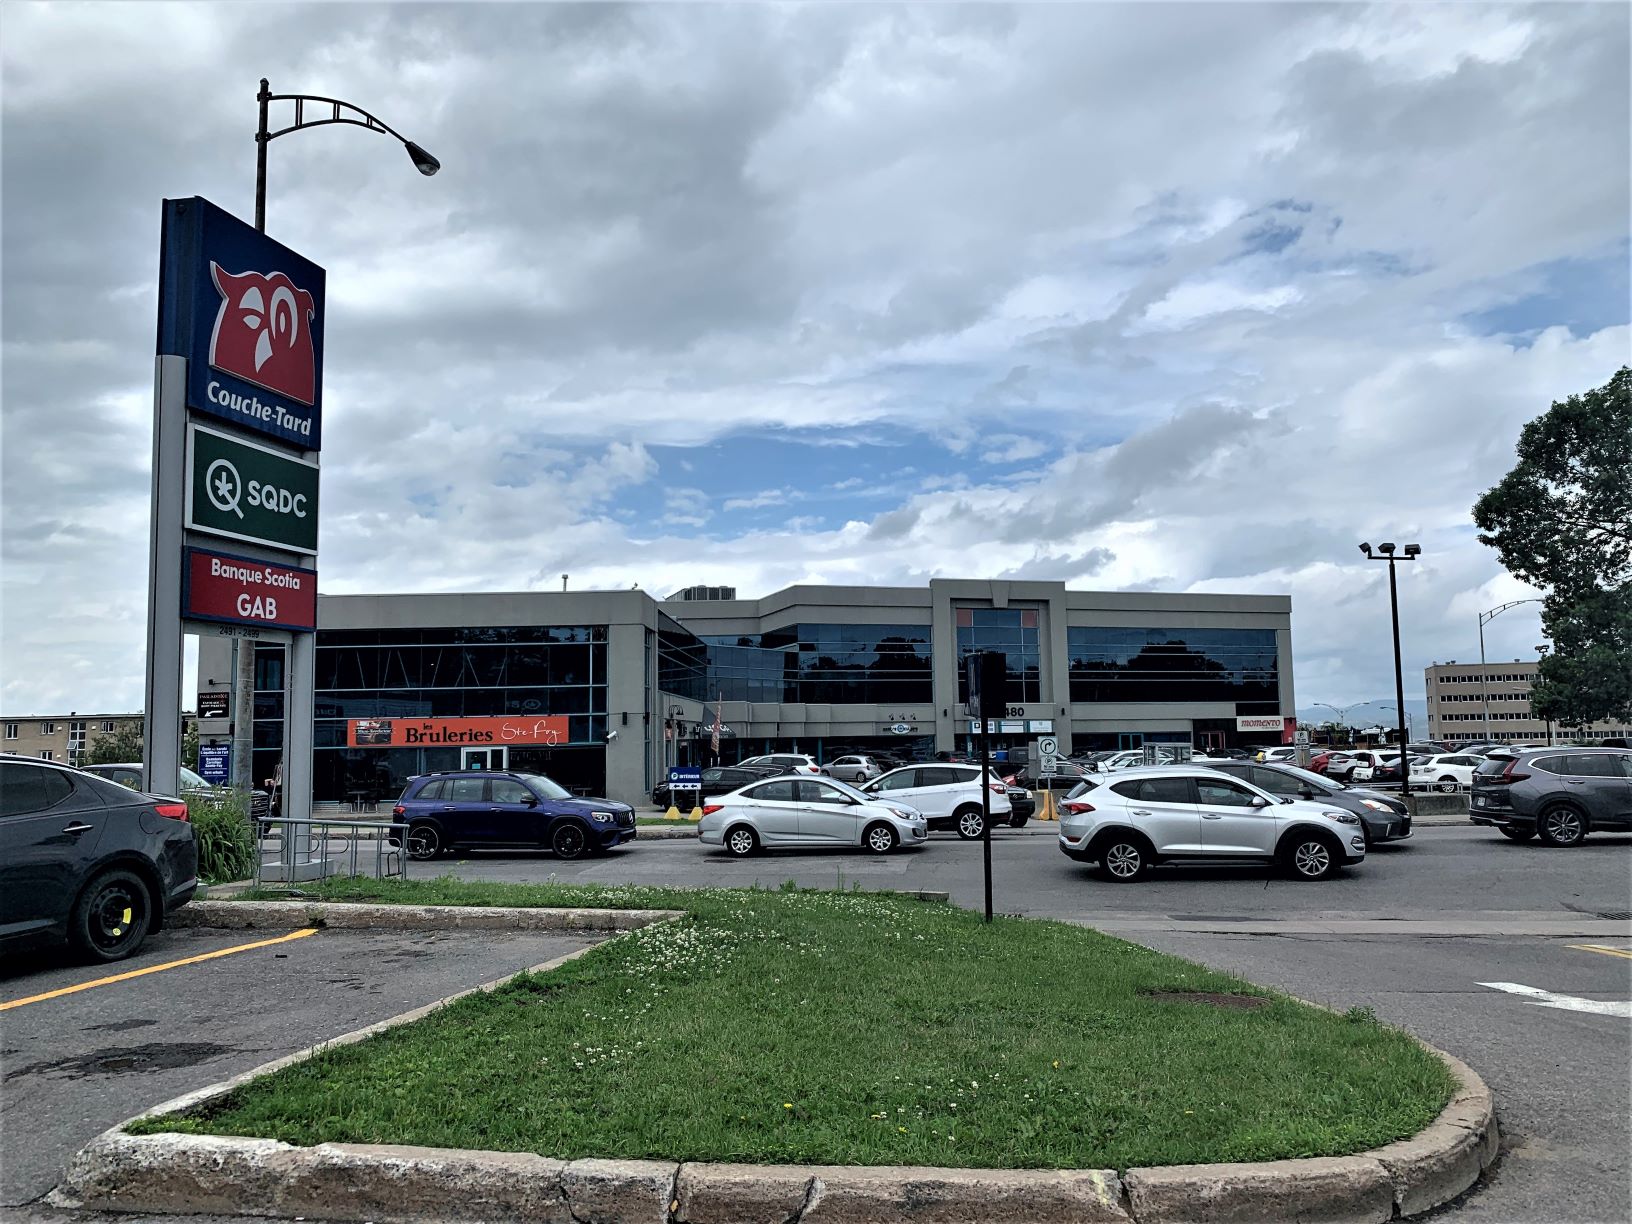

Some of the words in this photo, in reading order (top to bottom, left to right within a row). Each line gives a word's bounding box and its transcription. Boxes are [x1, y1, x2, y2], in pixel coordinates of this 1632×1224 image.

[207, 381, 312, 436] Couche-Tard
[247, 479, 307, 518] SQDC
[211, 558, 263, 586] Banque
[264, 568, 301, 590] Scotia
[236, 593, 277, 620] GAB
[219, 625, 236, 637] 2491
[405, 726, 493, 743] Bruleries
[501, 719, 562, 747] Ste-Foy
[423, 722, 433, 731] les
